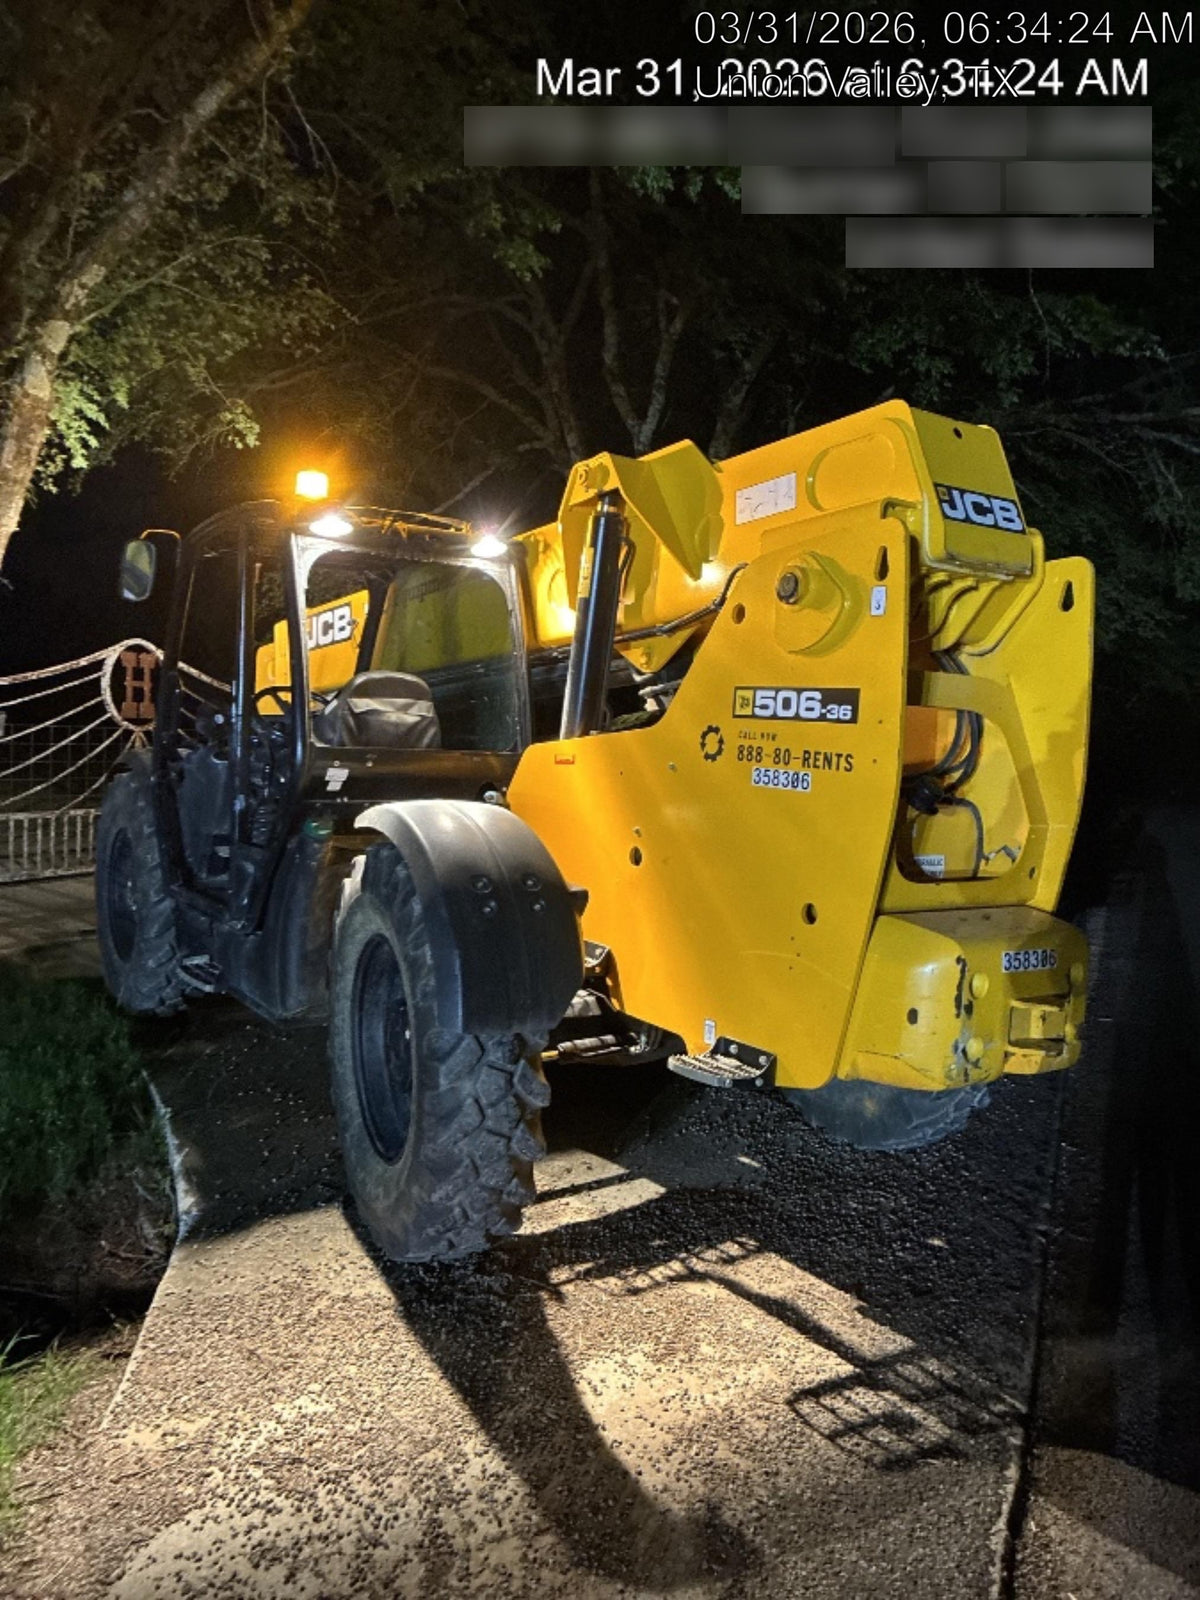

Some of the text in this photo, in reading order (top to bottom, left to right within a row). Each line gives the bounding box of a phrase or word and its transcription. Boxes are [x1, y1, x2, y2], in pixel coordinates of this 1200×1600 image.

[942, 489, 1023, 531] JCB
[306, 605, 351, 649] JCB
[753, 689, 852, 720] 506-36
[737, 745, 854, 772] 888-80-RENTS
[753, 768, 810, 790] 358306
[1004, 949, 1056, 971] 358306
